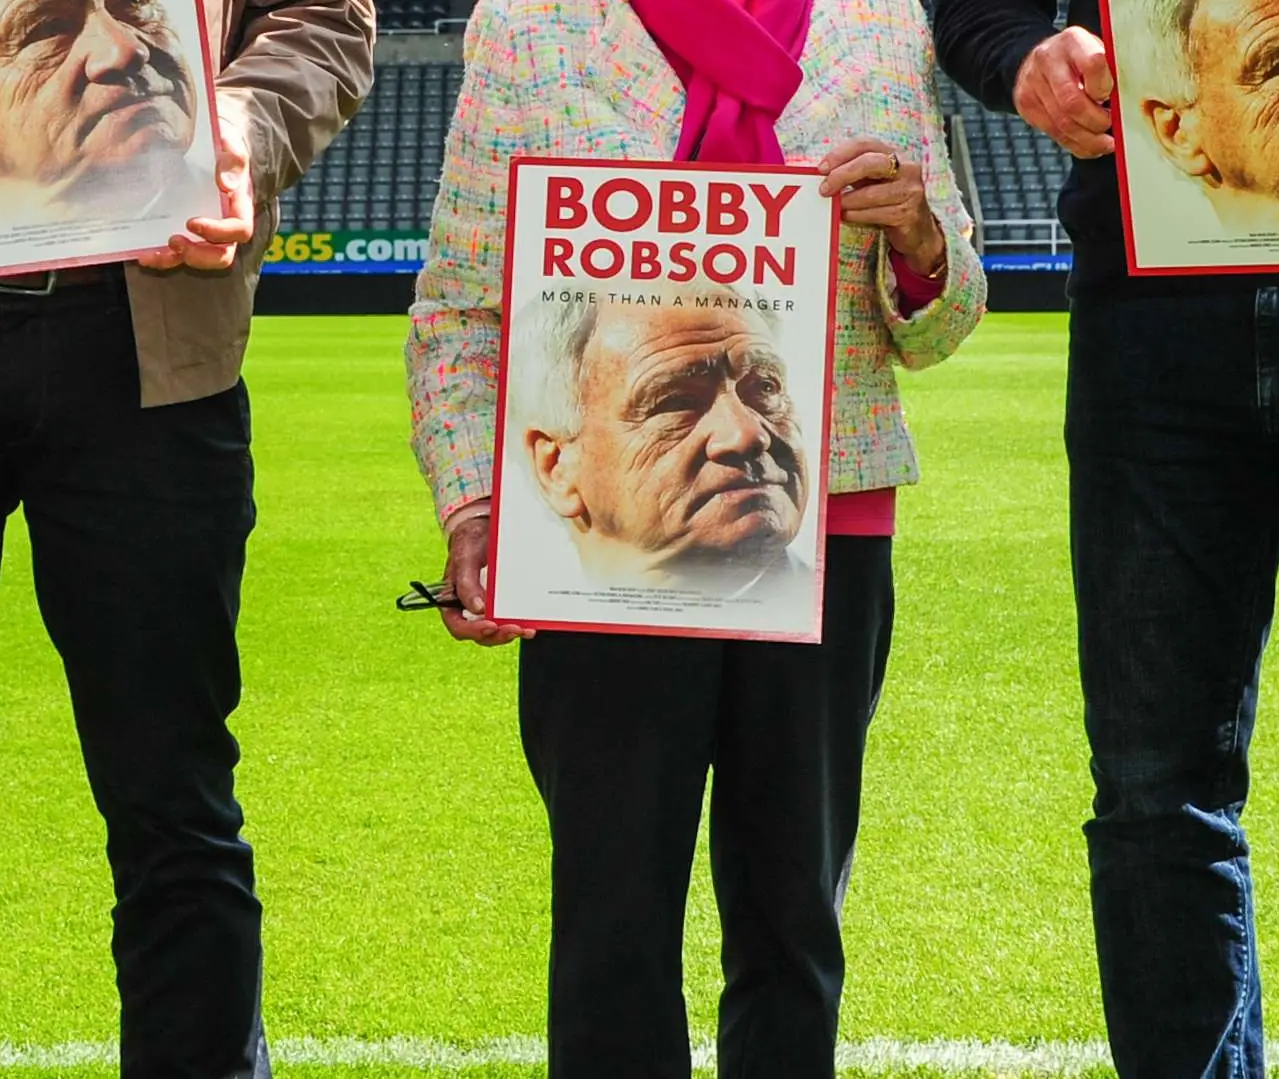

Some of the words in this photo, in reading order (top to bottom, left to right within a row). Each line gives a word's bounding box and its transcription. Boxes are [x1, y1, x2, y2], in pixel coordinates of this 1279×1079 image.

[545, 176, 802, 237] BOBBY
[543, 238, 796, 286] ROBSON
[542, 290, 597, 304] MORE
[608, 293, 661, 306] THAN
[673, 296, 684, 307] A
[695, 296, 795, 311] MANAGER
